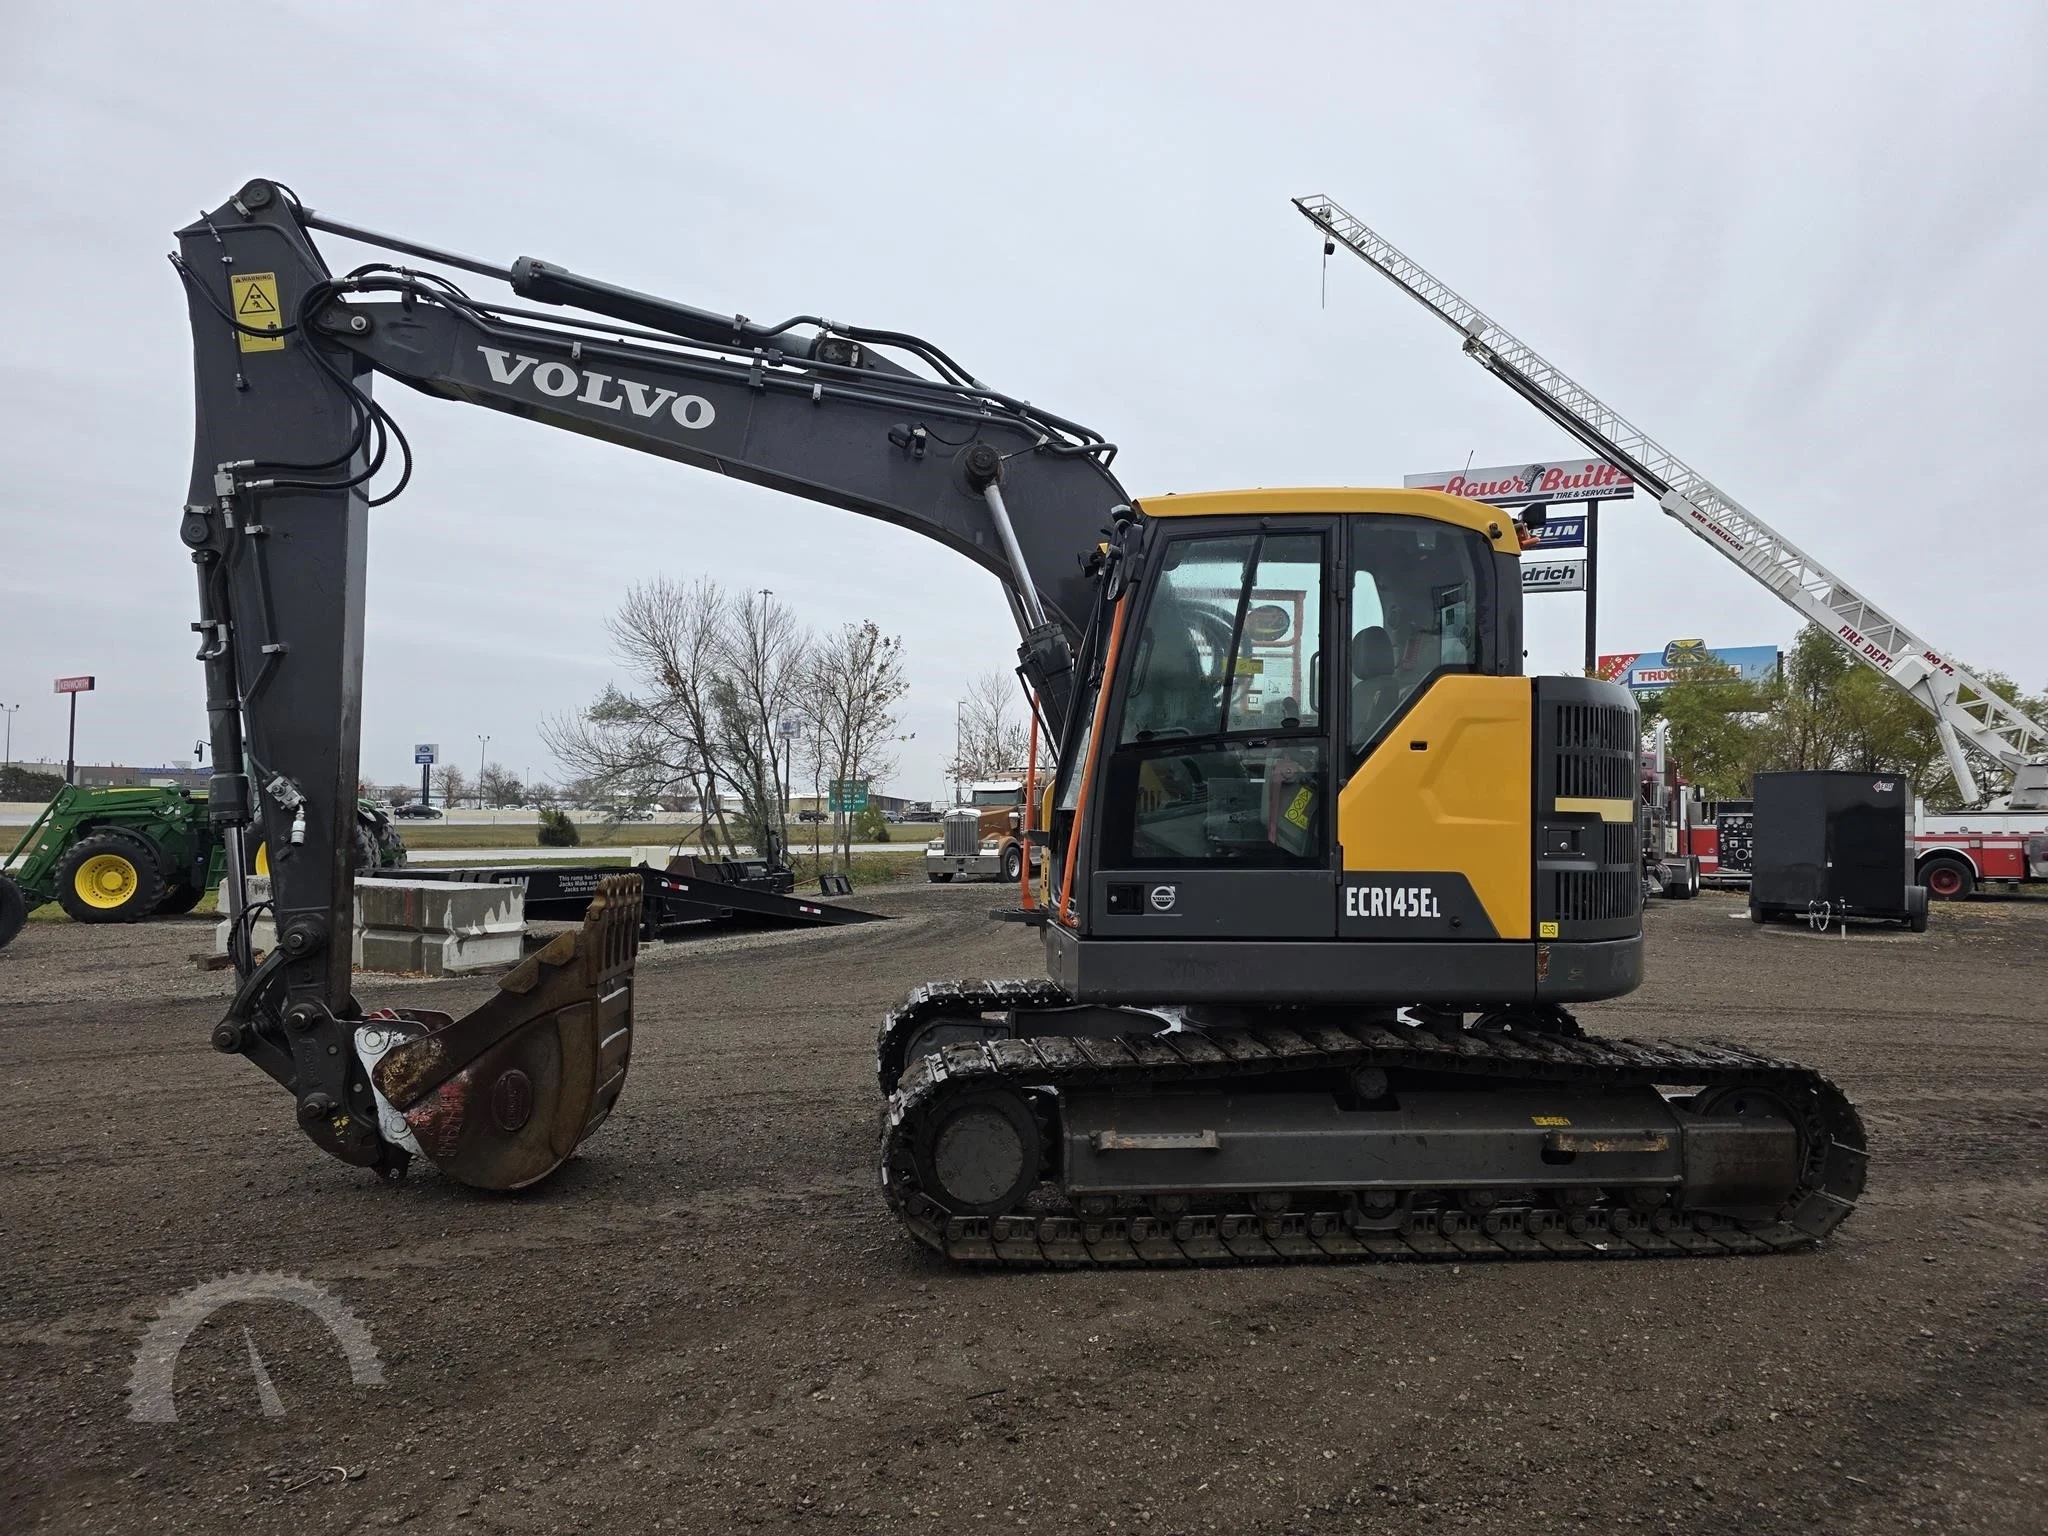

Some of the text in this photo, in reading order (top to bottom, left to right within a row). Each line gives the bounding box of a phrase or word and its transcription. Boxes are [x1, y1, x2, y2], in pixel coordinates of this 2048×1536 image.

[477, 345, 716, 430] VOLVO
[1445, 464, 1618, 497] Bauer Built
[1555, 491, 1573, 499] TIRE
[1580, 487, 1615, 498] SERVICE
[1837, 624, 1893, 670] FIRE DEPT.
[1922, 650, 1942, 665] 100
